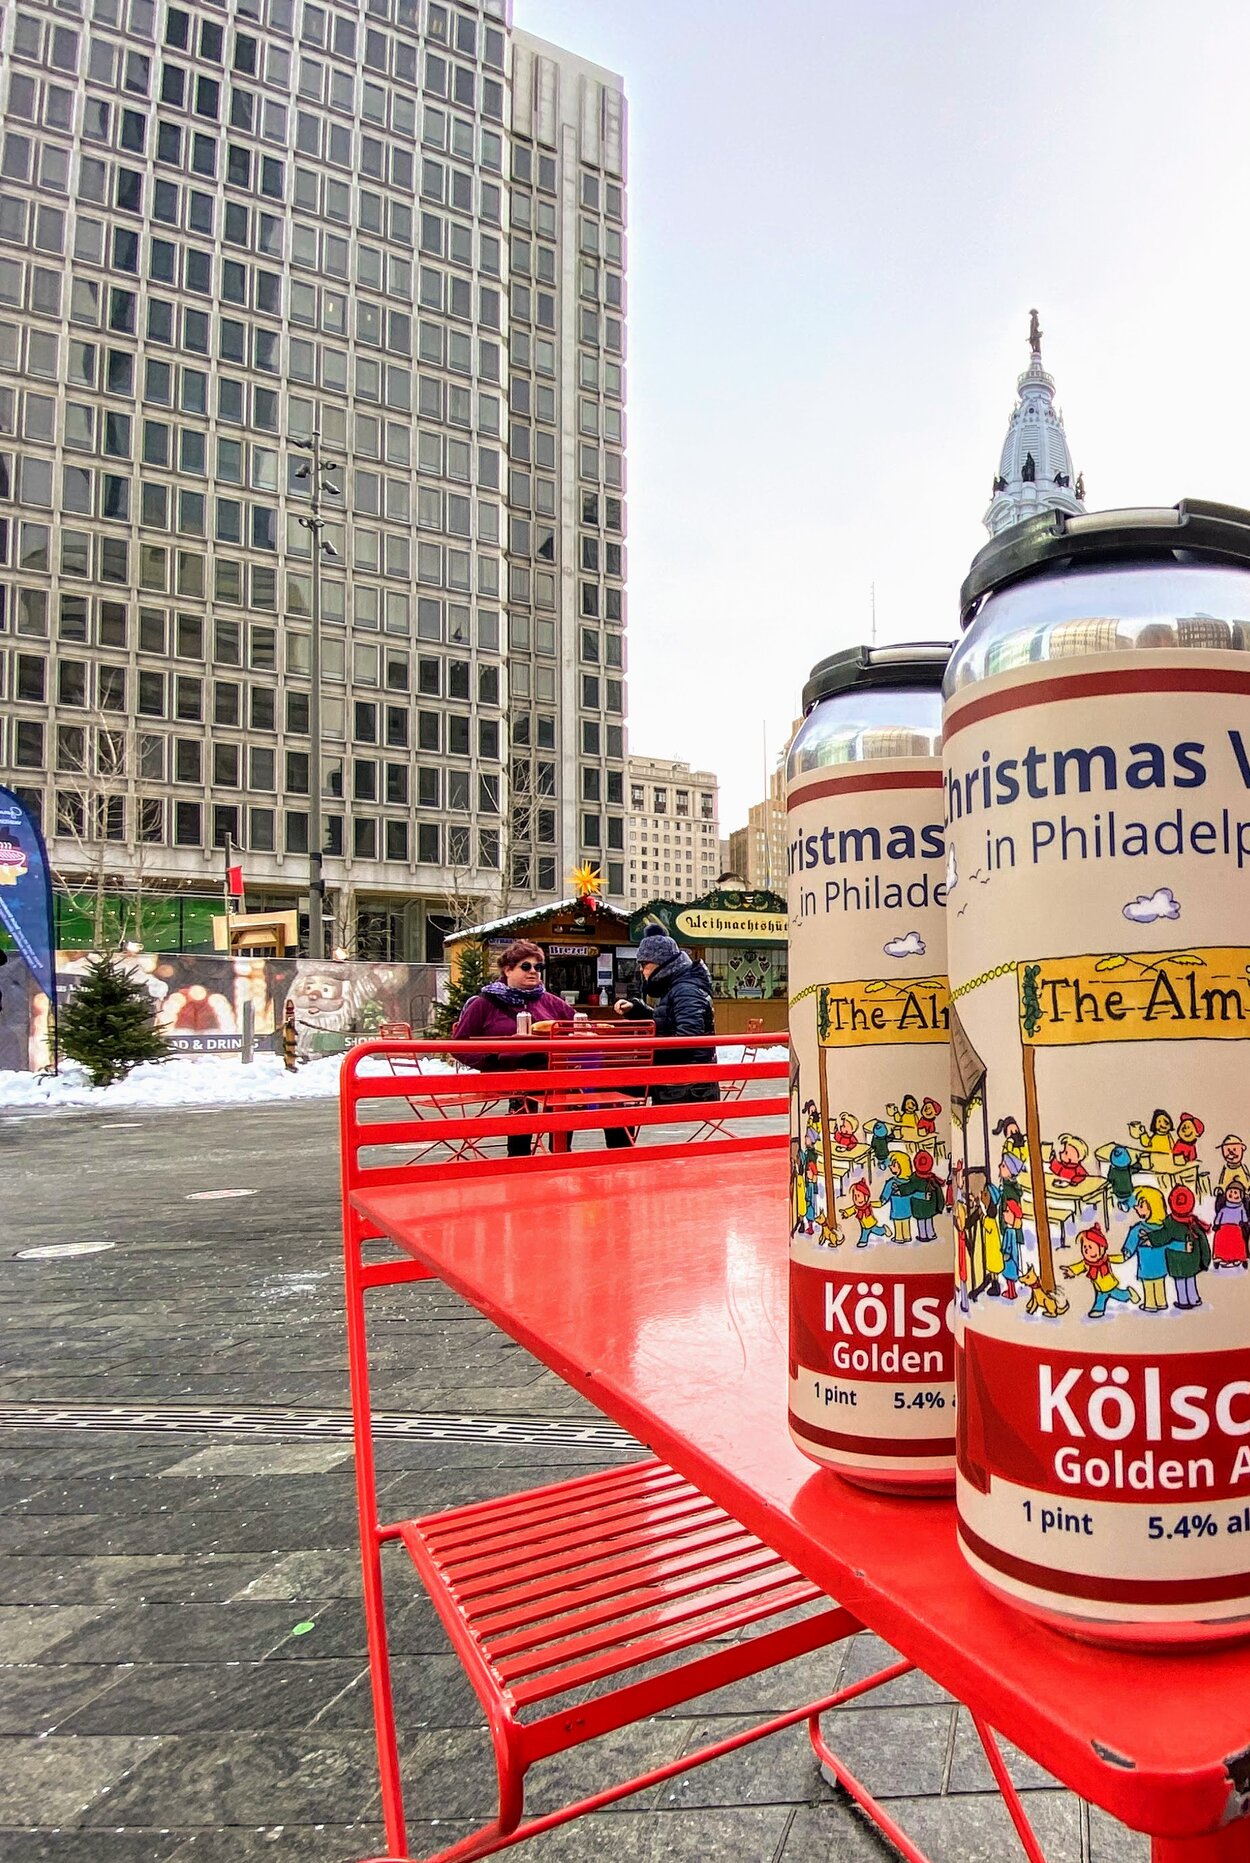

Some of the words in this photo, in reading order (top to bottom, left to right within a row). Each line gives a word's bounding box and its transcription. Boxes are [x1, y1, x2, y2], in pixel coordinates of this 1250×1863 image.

[787, 825, 945, 876] ristmas
[986, 829, 1015, 871] in
[800, 886, 817, 917] in
[825, 873, 947, 913] Philade
[685, 915, 788, 933] Weihnachtshüt
[829, 997, 885, 1031] The
[1040, 977, 1127, 1023] The
[1142, 969, 1246, 1021] Alm
[193, 1039, 203, 1050] &
[207, 1038, 259, 1050] DRINS
[824, 1281, 955, 1338] Köls
[833, 1341, 944, 1373] Golden
[814, 1382, 820, 1398] 1
[825, 1385, 857, 1407] pint
[893, 1392, 945, 1409] 5.4%
[1054, 1446, 1215, 1491] Golden
[1022, 1500, 1032, 1523] 1
[1041, 1506, 1093, 1536] pint
[1147, 1513, 1218, 1540] 5.4%
